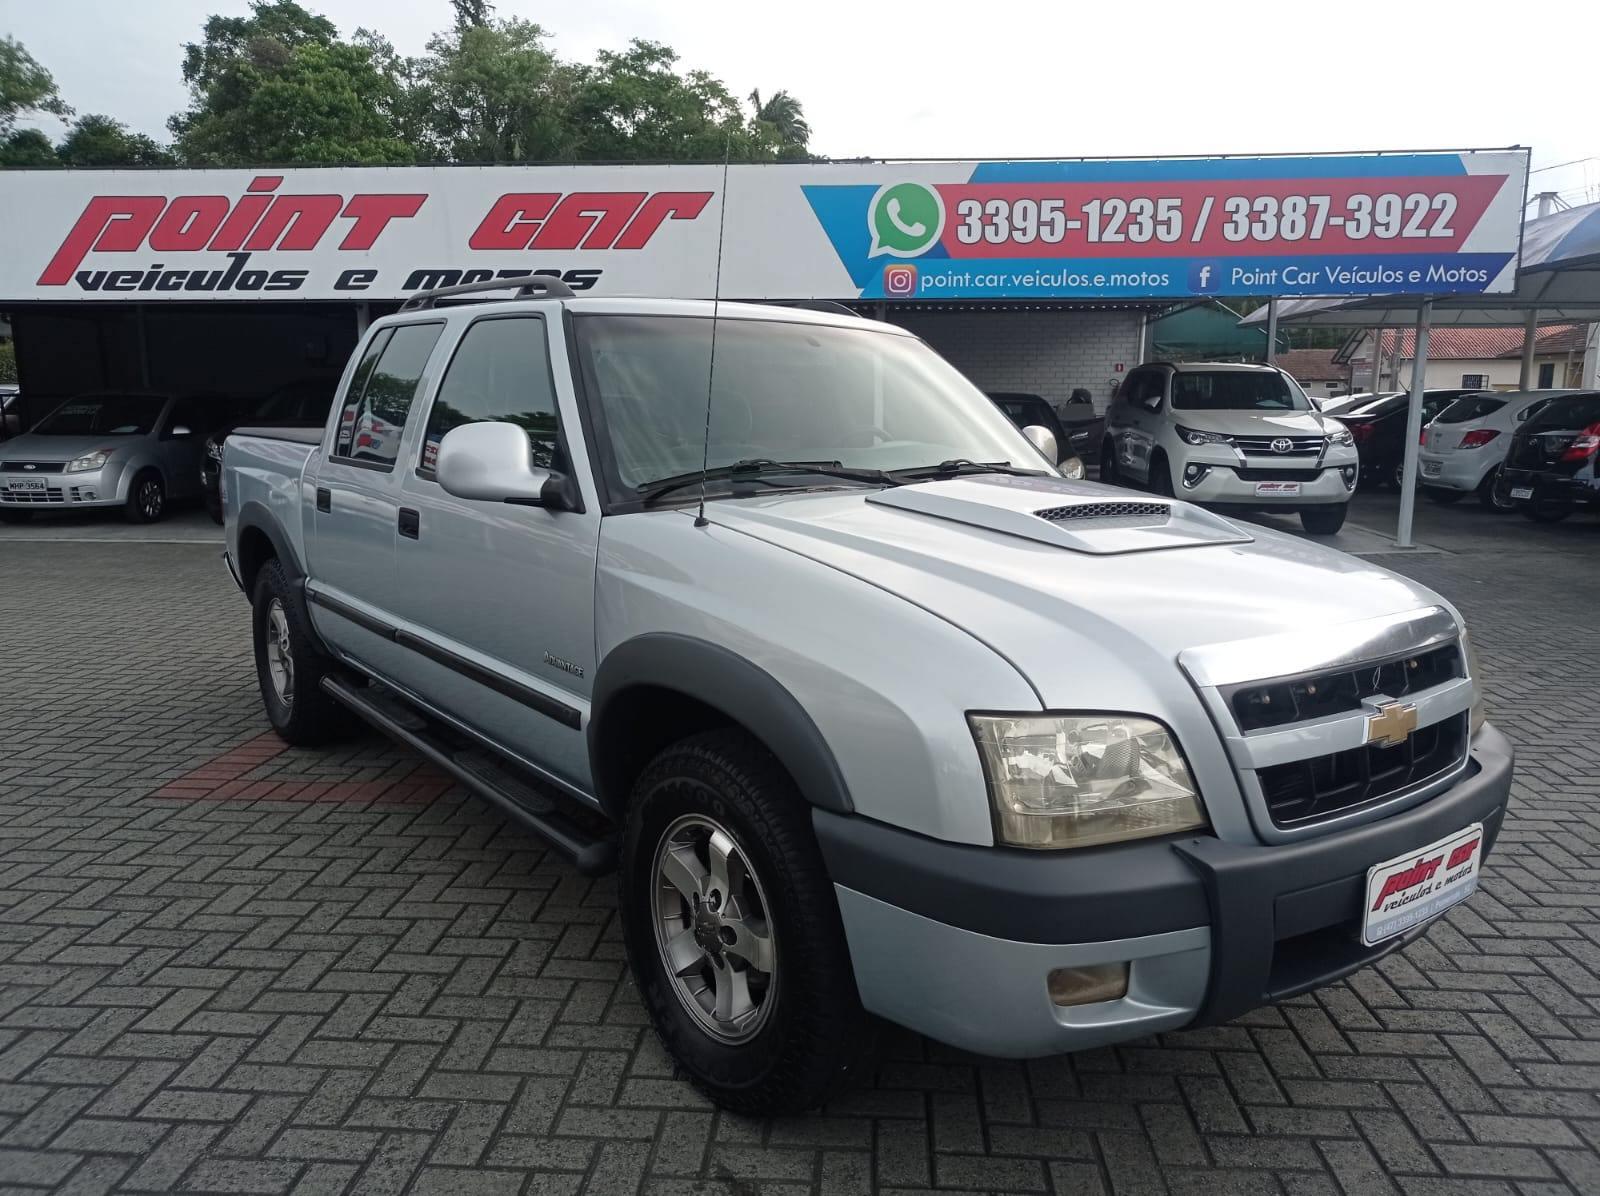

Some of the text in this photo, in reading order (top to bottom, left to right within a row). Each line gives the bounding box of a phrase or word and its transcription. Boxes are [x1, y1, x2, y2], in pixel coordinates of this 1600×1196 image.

[956, 192, 1458, 244] 3395-1235 / 3387-3922
[75, 252, 603, 291] veiculos e mots
[921, 269, 1169, 292] point.car.veiculos.e.motos
[1231, 264, 1487, 285] Point Car Veículos e Motos
[1384, 884, 1433, 912] veiculos
[1434, 881, 1442, 890] e
[1444, 862, 1473, 886] motos
